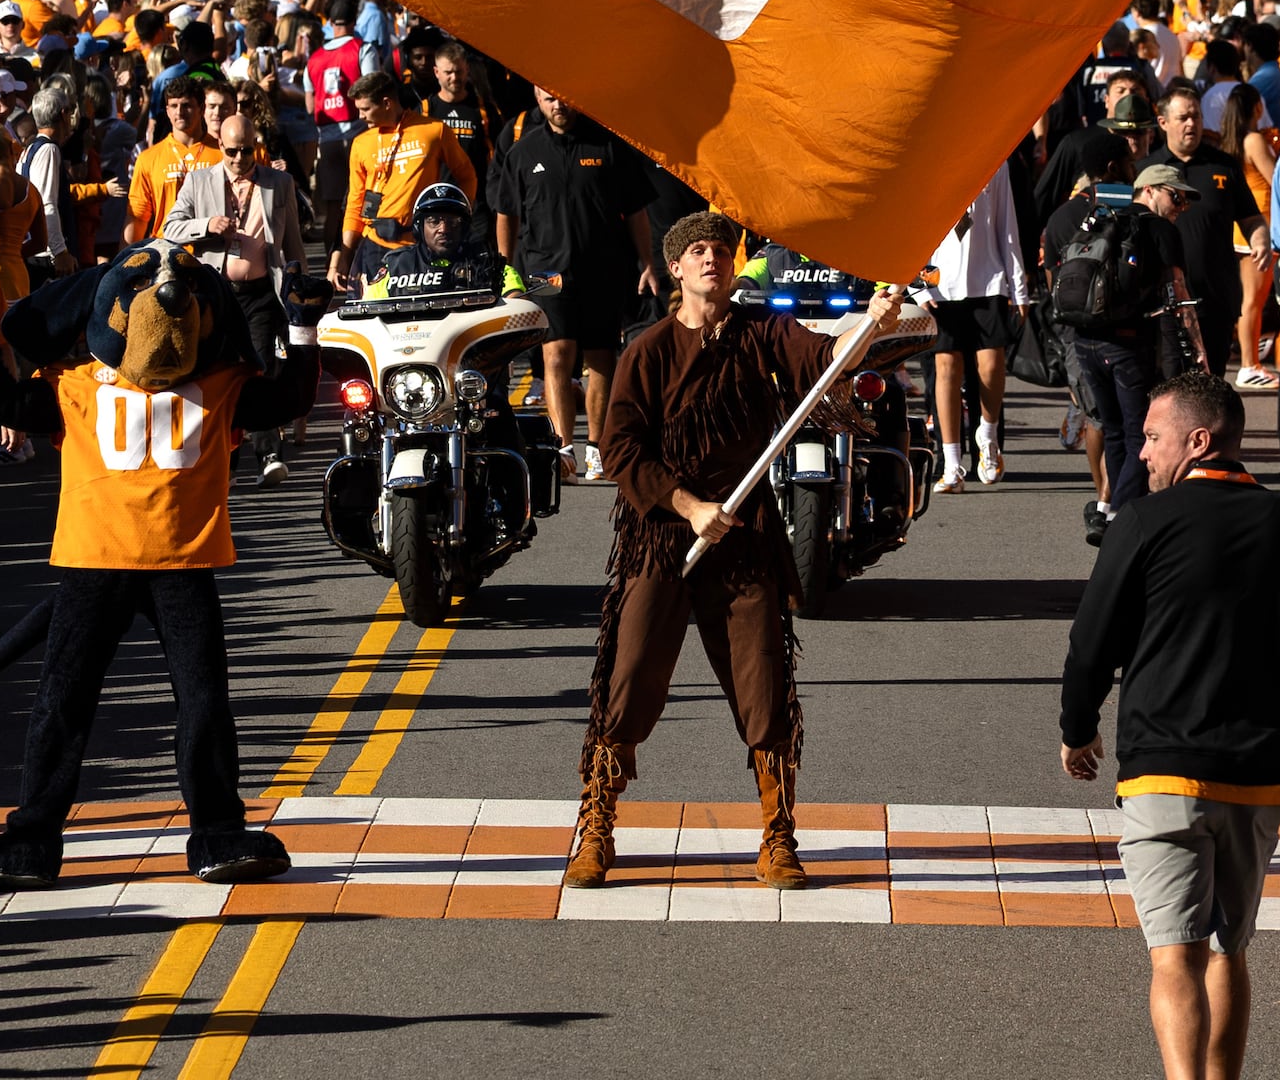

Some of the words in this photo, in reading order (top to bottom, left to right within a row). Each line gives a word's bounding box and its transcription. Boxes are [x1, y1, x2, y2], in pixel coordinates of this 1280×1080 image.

[324, 96, 344, 110] 018
[395, 159, 408, 174] T
[580, 158, 602, 167] VOLS
[1213, 174, 1227, 189] T
[387, 271, 443, 290] POLICE
[782, 268, 839, 283] POLICE
[96, 383, 203, 471] 00
